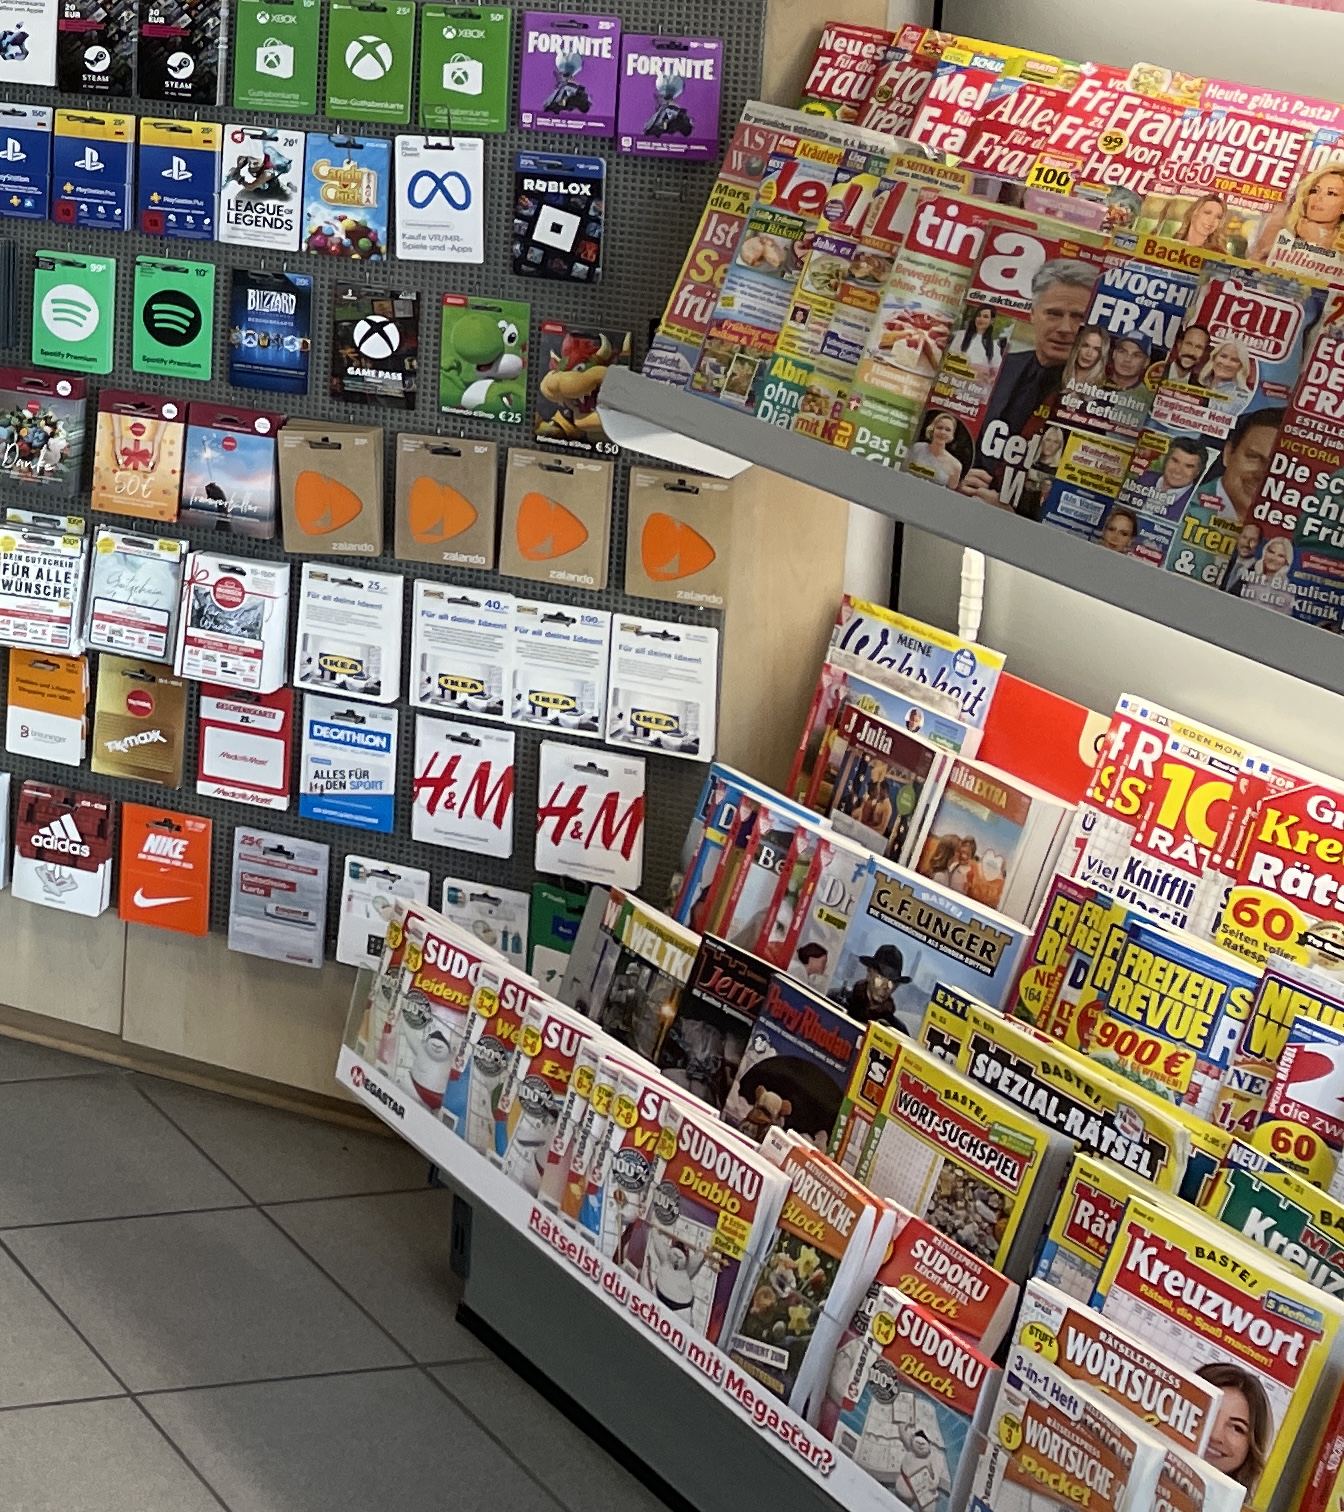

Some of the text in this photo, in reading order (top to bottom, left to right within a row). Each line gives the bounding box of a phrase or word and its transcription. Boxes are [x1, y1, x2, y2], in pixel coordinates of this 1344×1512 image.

[527, 31, 614, 60] FORTNITE
[625, 52, 715, 81] FORTNITE
[1205, 83, 1340, 122] Heute gibt's Pasta!
[523, 179, 592, 197] ROBLOX
[1034, 168, 1071, 186] 100
[226, 200, 284, 218] LEAGUE
[226, 212, 294, 233] LEGENDS
[247, 289, 298, 314] BLIZZARD
[331, 541, 375, 553] zalando
[442, 551, 486, 564] zalando
[1, 575, 71, 600] WÜNSCHE
[322, 658, 362, 676] IKEA
[635, 711, 676, 730] IKEA
[312, 725, 388, 750] DECATHLON
[312, 766, 370, 781] ALLES FÜR
[414, 751, 514, 829] H&M
[536, 781, 644, 862] H&M
[31, 831, 90, 859] adidas
[142, 832, 187, 861] NIKE
[1232, 897, 1294, 941] 60
[916, 910, 998, 961] UNGER
[1120, 942, 1227, 1013] FREIZEIT
[1109, 976, 1213, 1049] REVUE
[971, 1047, 1153, 1179] SPEZIAL-RÄTSEL
[897, 1088, 1020, 1187] WORT-SUCHSPIEL
[679, 1116, 762, 1203] SUDOKU
[679, 1167, 742, 1214] Diablo
[1125, 1240, 1305, 1367] Kreuzwort
[528, 1206, 835, 1476] Rätselst du schon mit Megastar?
[896, 1304, 984, 1388] SUDOKU
[1065, 1327, 1203, 1442] WORTSUCHE
